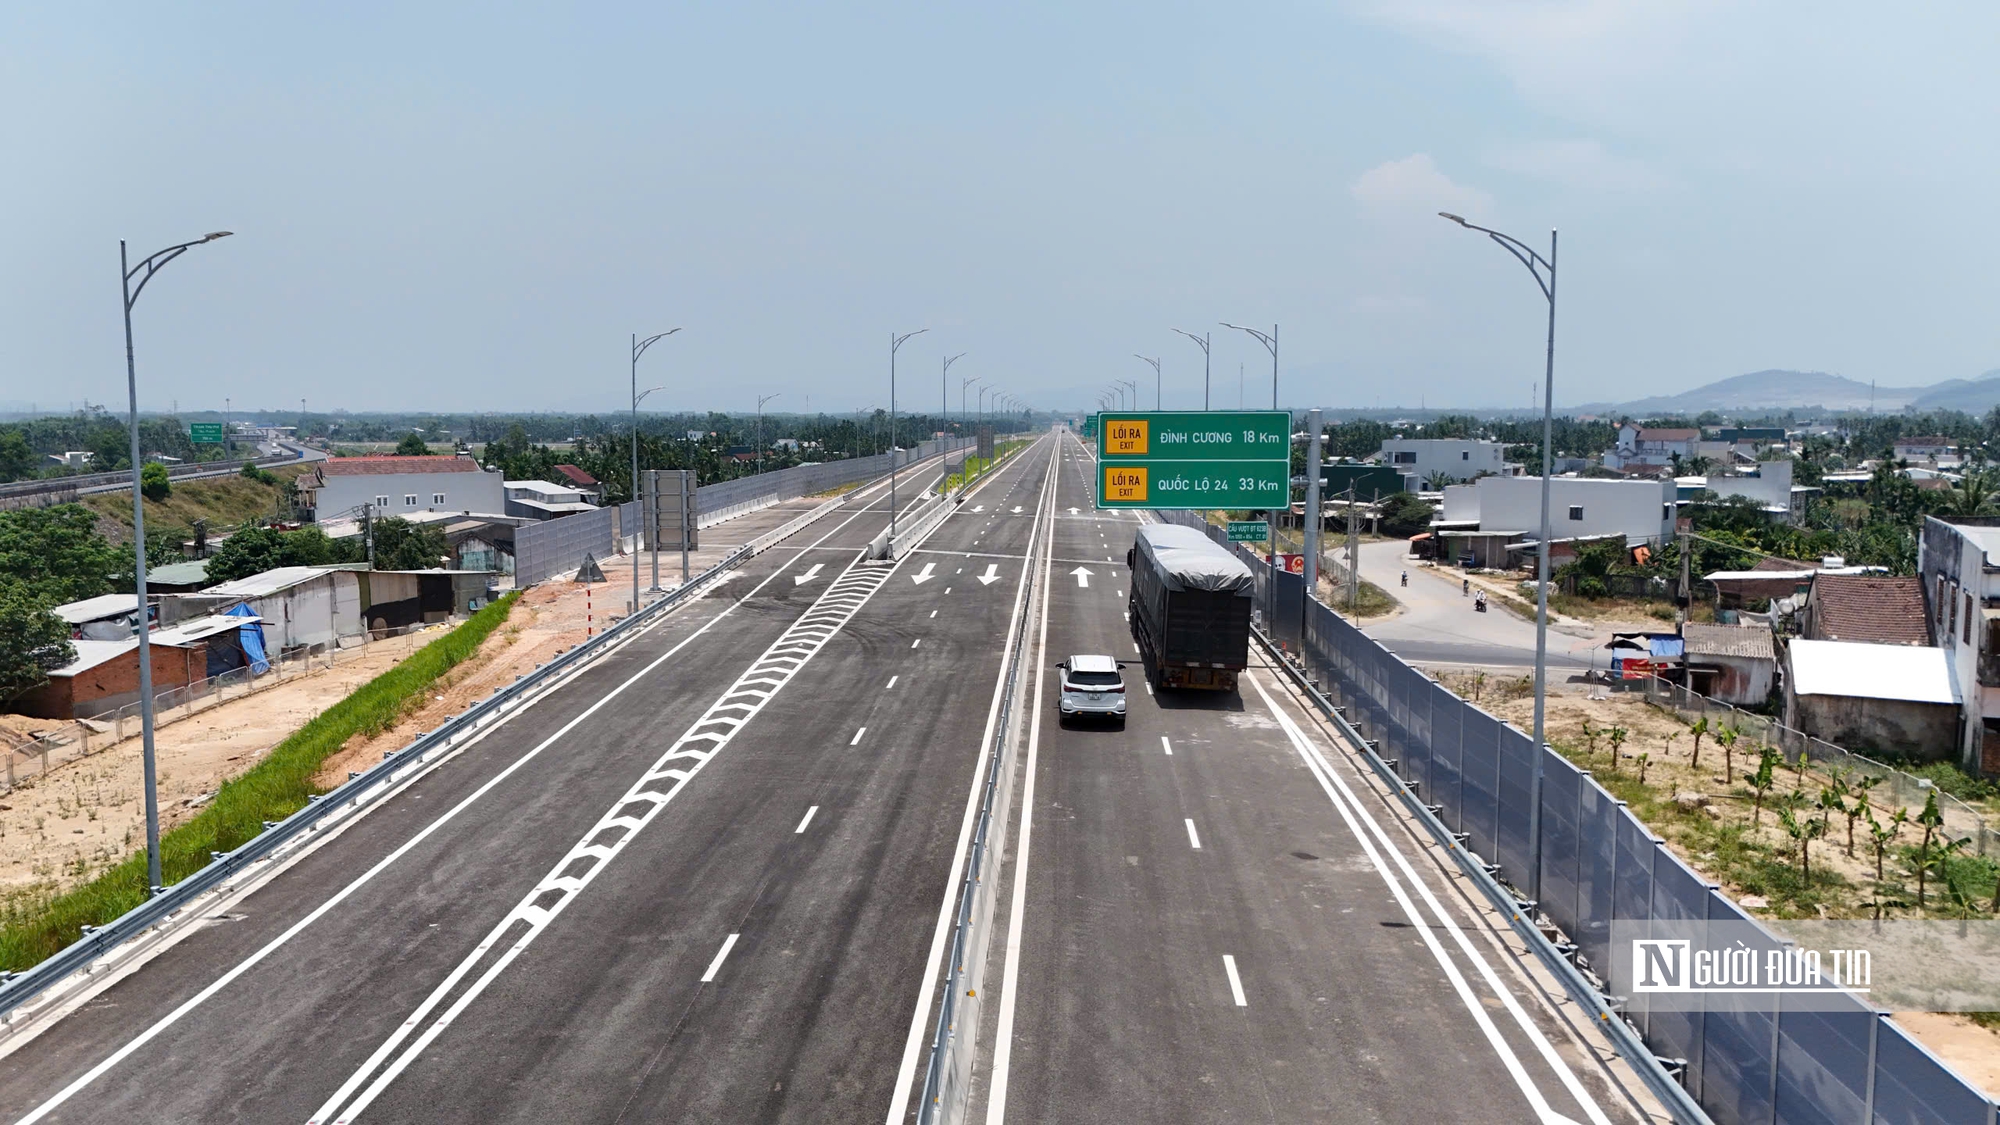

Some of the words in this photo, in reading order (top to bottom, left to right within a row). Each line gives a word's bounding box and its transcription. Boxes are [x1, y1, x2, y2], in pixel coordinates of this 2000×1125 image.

[1113, 424, 1126, 439] LỐI
[1130, 428, 1141, 439] RA
[1160, 429, 1188, 443] ĐÌNH
[1192, 431, 1232, 443] CƯƠNG
[1243, 430, 1255, 443] 18
[1259, 432, 1280, 443] Km
[1119, 441, 1134, 450] EXIT
[1112, 471, 1126, 486] LỐI
[1128, 475, 1140, 486] RA
[1158, 473, 1190, 491] QUỐC
[1194, 477, 1210, 493] LỘ
[1214, 479, 1228, 490] 24
[1239, 478, 1254, 490] 33
[1258, 480, 1279, 490] Km
[1119, 488, 1133, 497] EXIT
